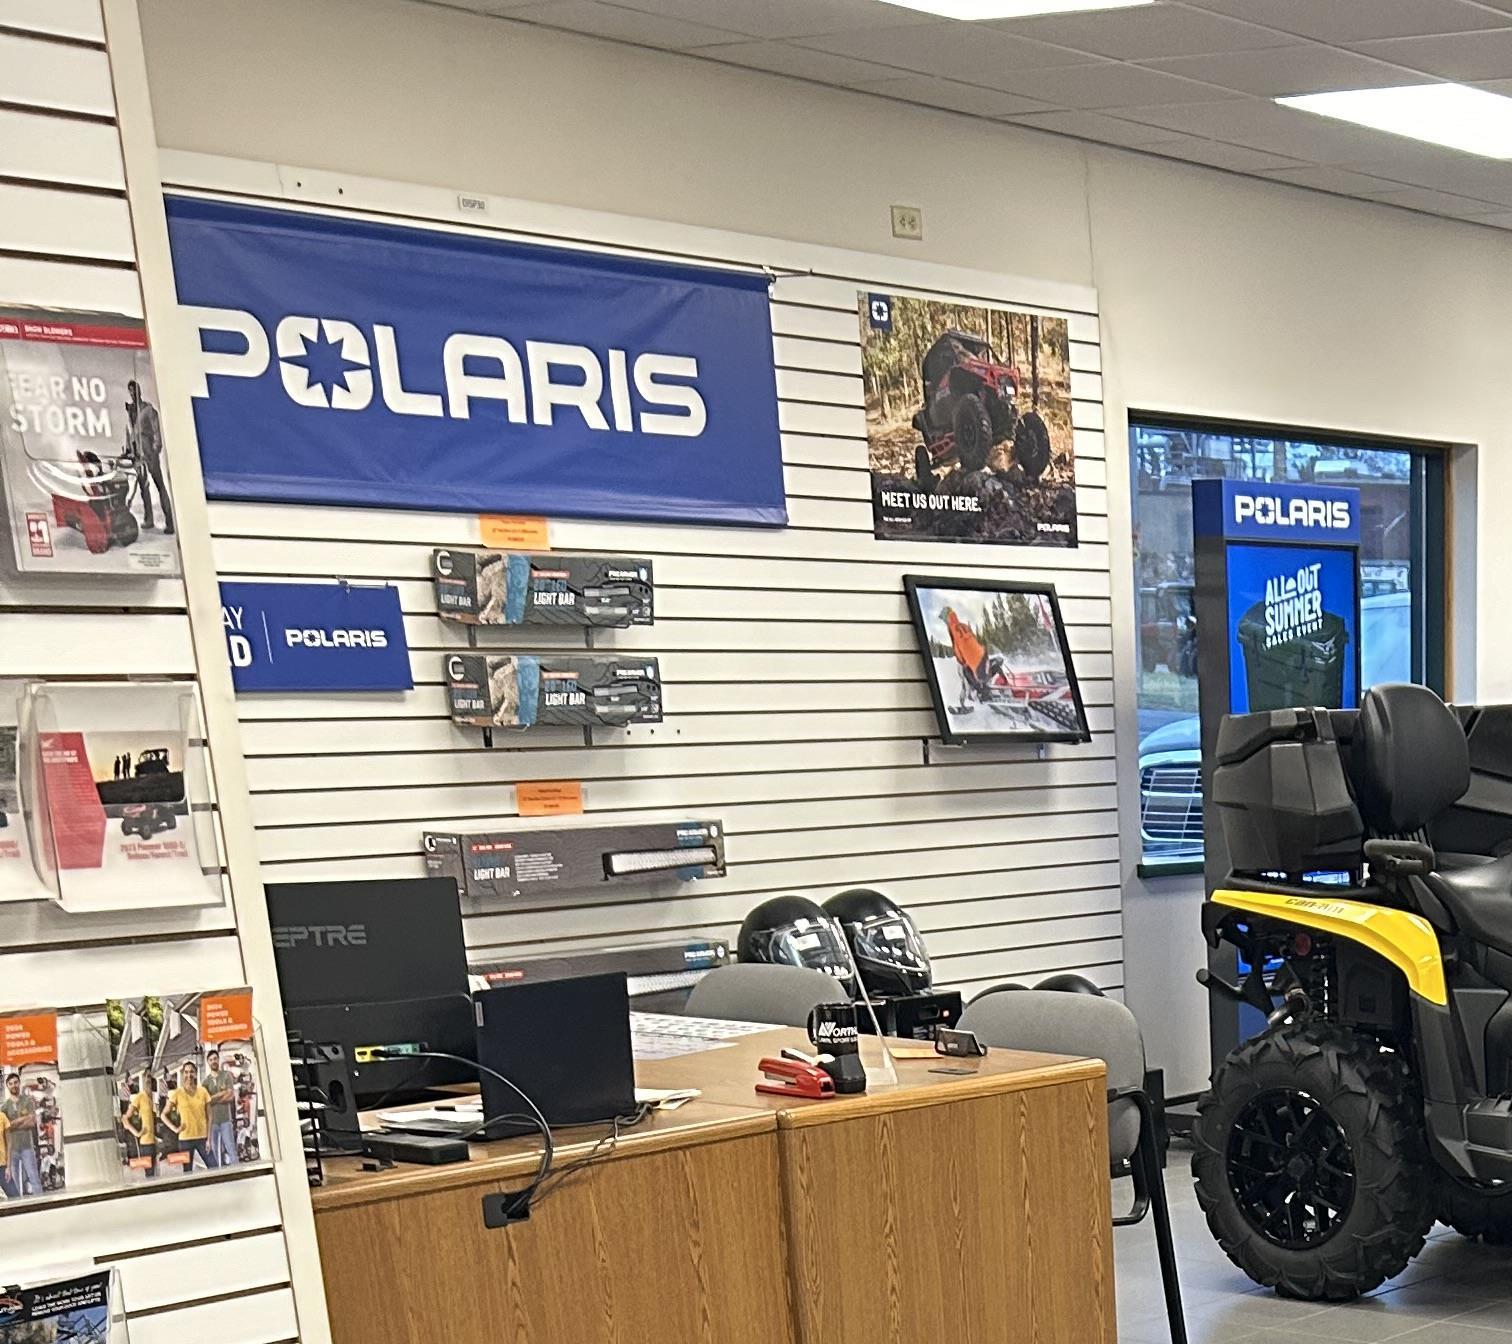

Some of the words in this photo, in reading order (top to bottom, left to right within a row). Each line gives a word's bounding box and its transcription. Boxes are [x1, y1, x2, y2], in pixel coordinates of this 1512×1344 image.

[180, 304, 708, 438] POLARIS
[72, 376, 106, 402] NO
[10, 405, 112, 437] STORM
[881, 491, 911, 508] MEET
[912, 494, 927, 509] US
[929, 495, 949, 510] OUT
[951, 496, 983, 512] HERE.
[1234, 495, 1350, 529] POLARIS
[1265, 575, 1297, 606] ALL
[1297, 563, 1322, 594] OUT
[533, 592, 557, 606] LIGHT
[558, 593, 576, 606] BAR
[1265, 590, 1323, 636] SUMMER
[285, 629, 388, 648] POLARIS
[545, 693, 568, 706] LIGHT
[569, 693, 586, 706] BAR
[473, 868, 494, 881] LIGHT
[495, 866, 510, 879] BAR
